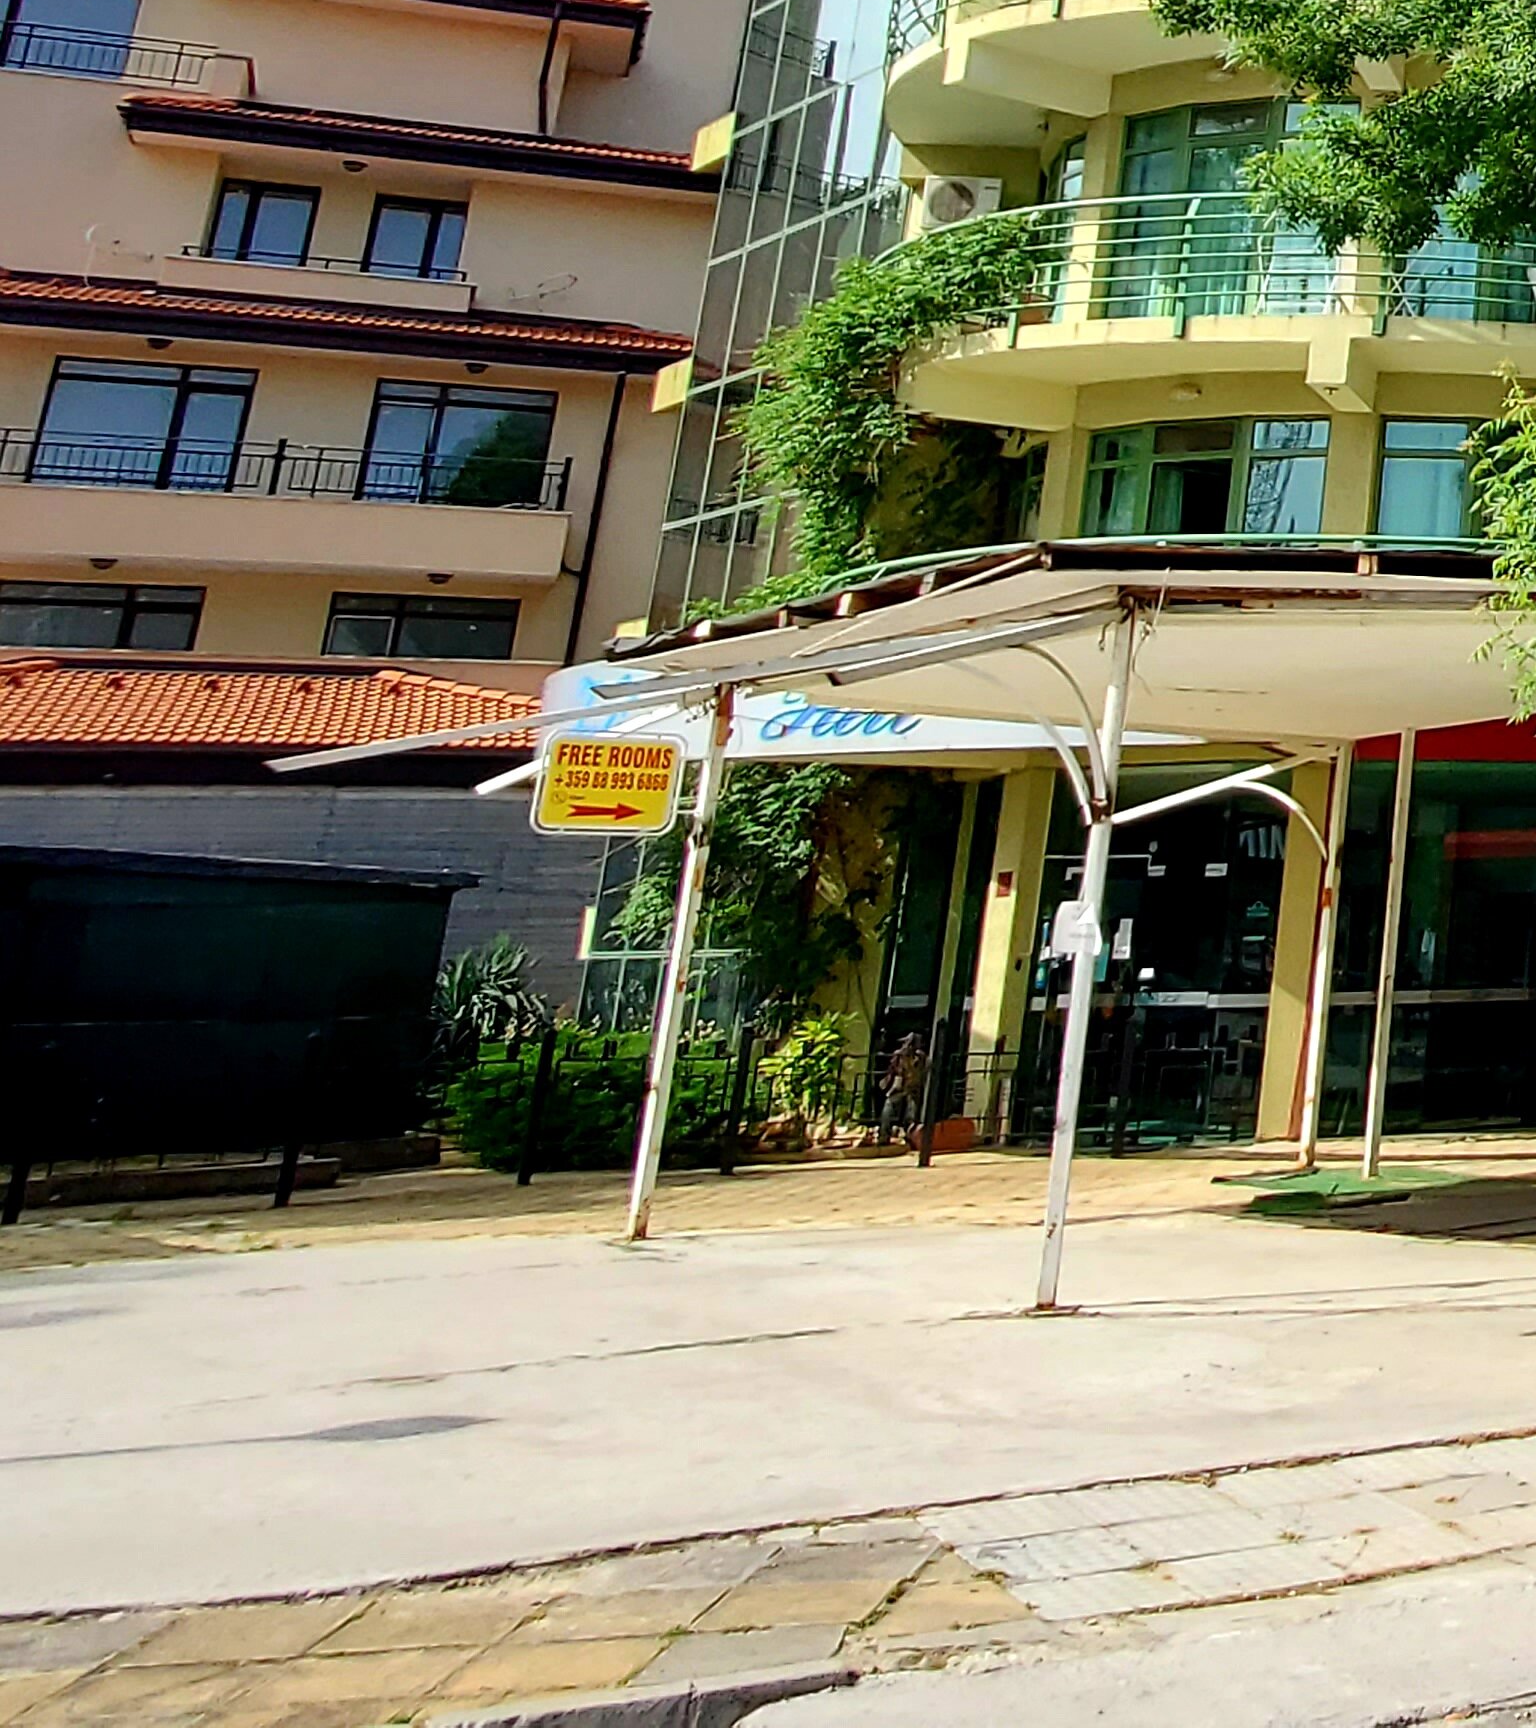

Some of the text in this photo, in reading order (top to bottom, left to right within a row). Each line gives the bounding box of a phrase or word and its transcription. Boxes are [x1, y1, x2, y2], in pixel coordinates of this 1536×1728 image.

[556, 743, 674, 770] FREE ROOMS
[554, 770, 590, 789] +359
[610, 772, 634, 790] 993
